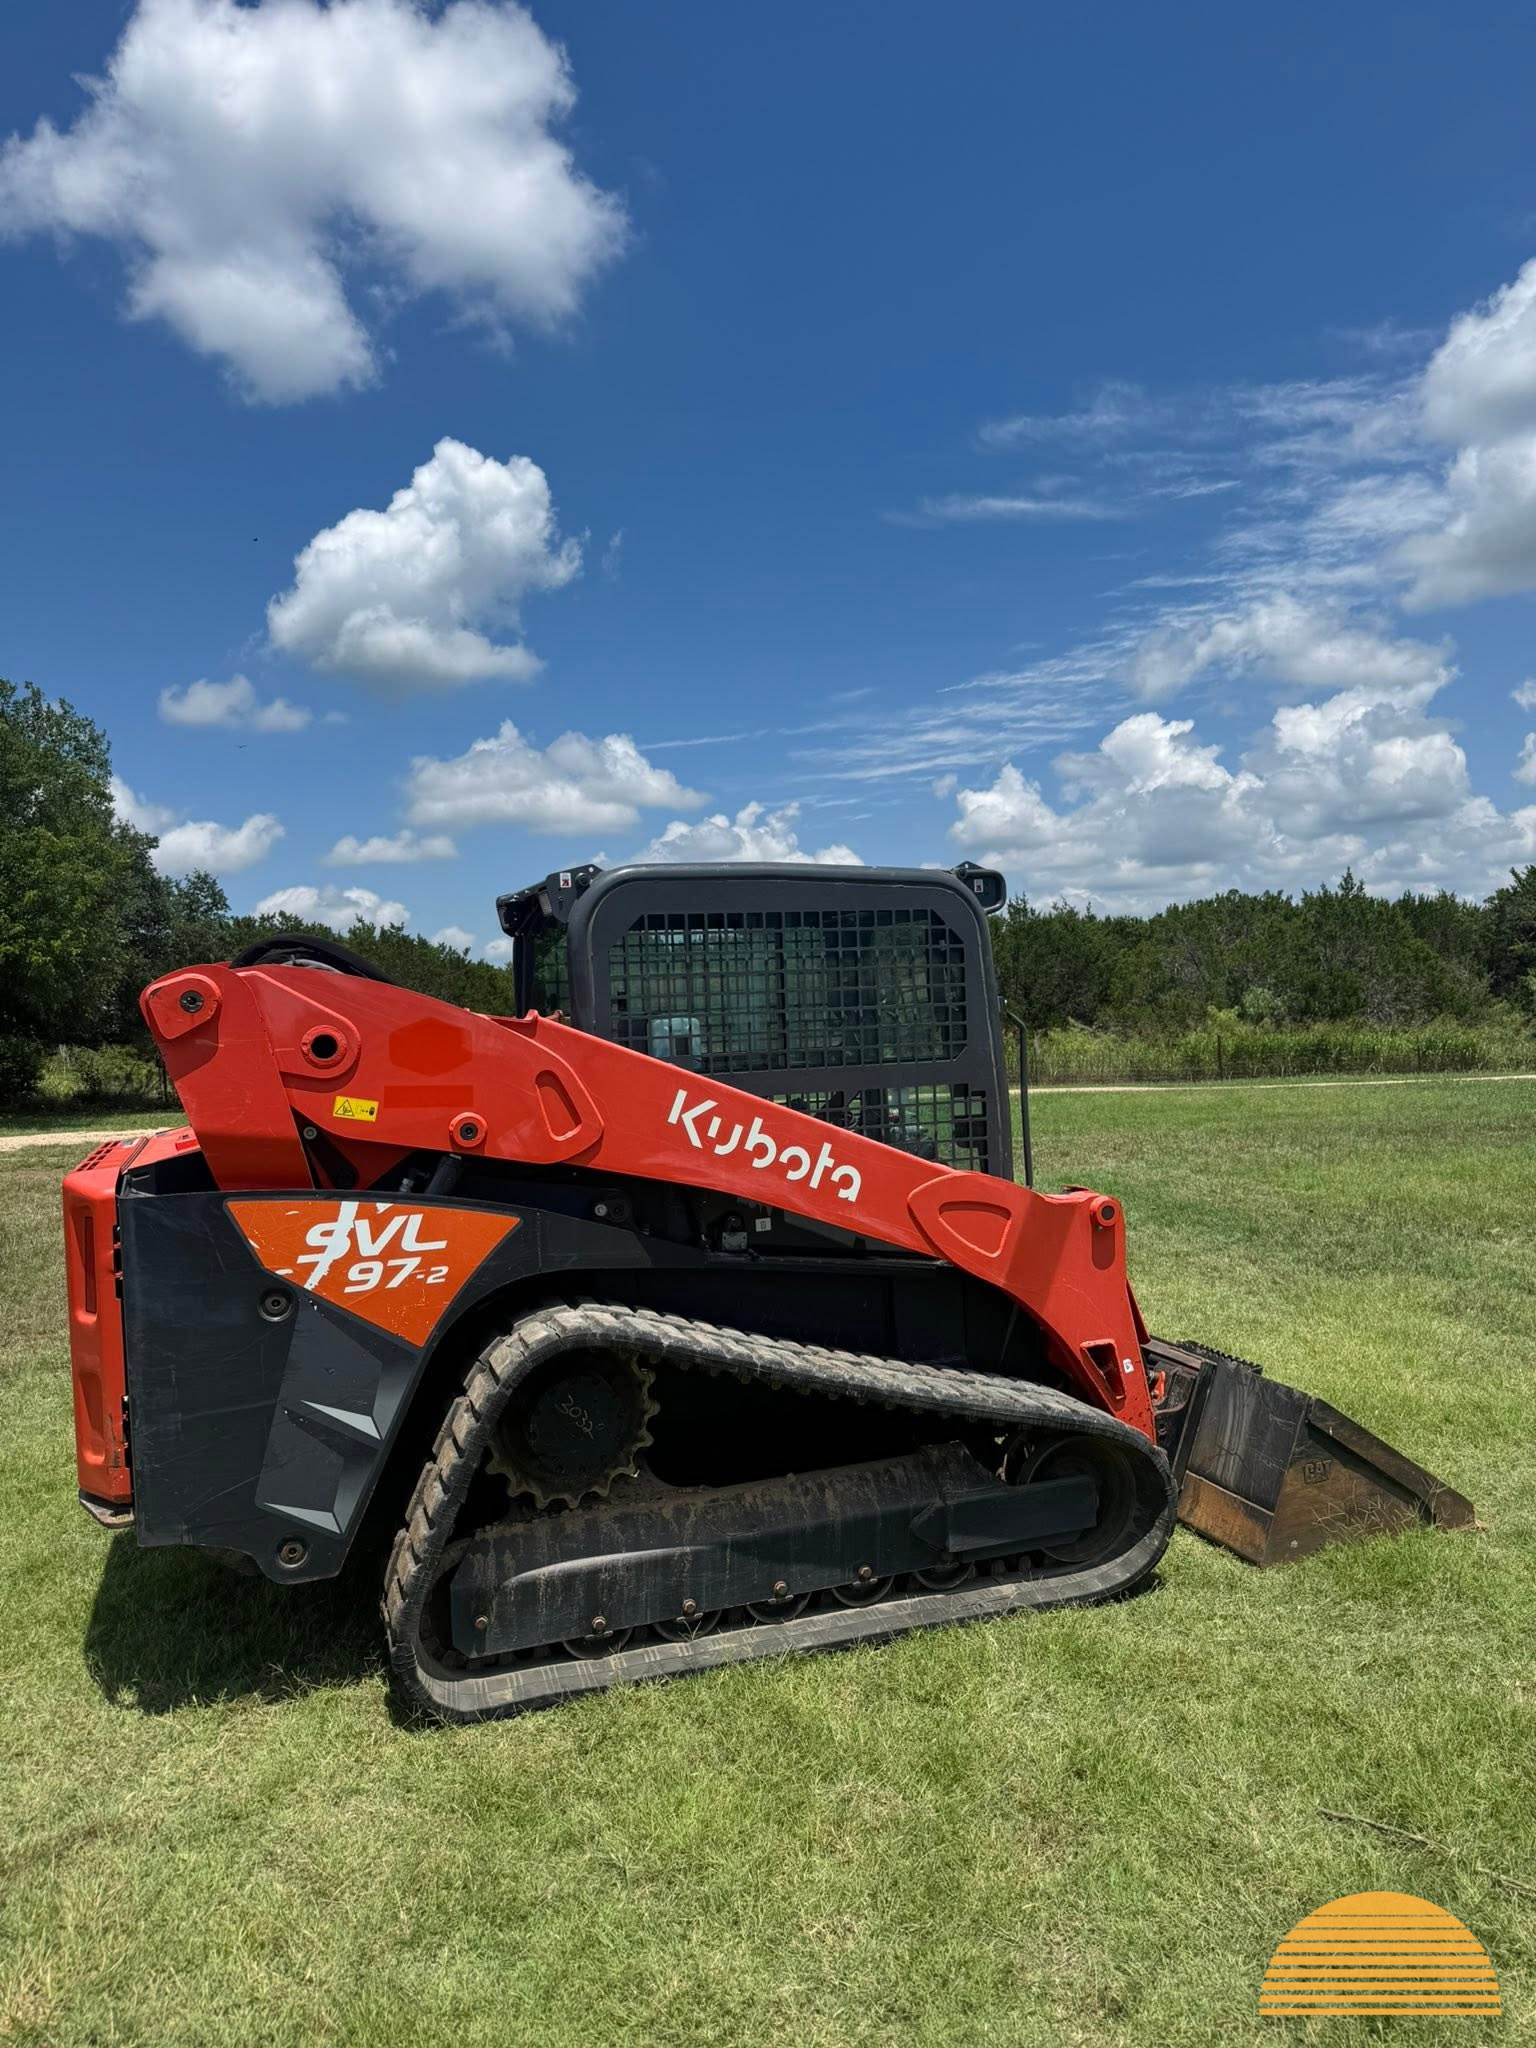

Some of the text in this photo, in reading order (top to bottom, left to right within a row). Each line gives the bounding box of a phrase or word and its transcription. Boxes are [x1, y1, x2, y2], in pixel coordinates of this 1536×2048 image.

[667, 1088, 862, 1203] Kubota
[297, 1211, 448, 1264] SVL
[344, 1256, 449, 1294] 97-2
[1303, 1460, 1333, 1485] CAT
